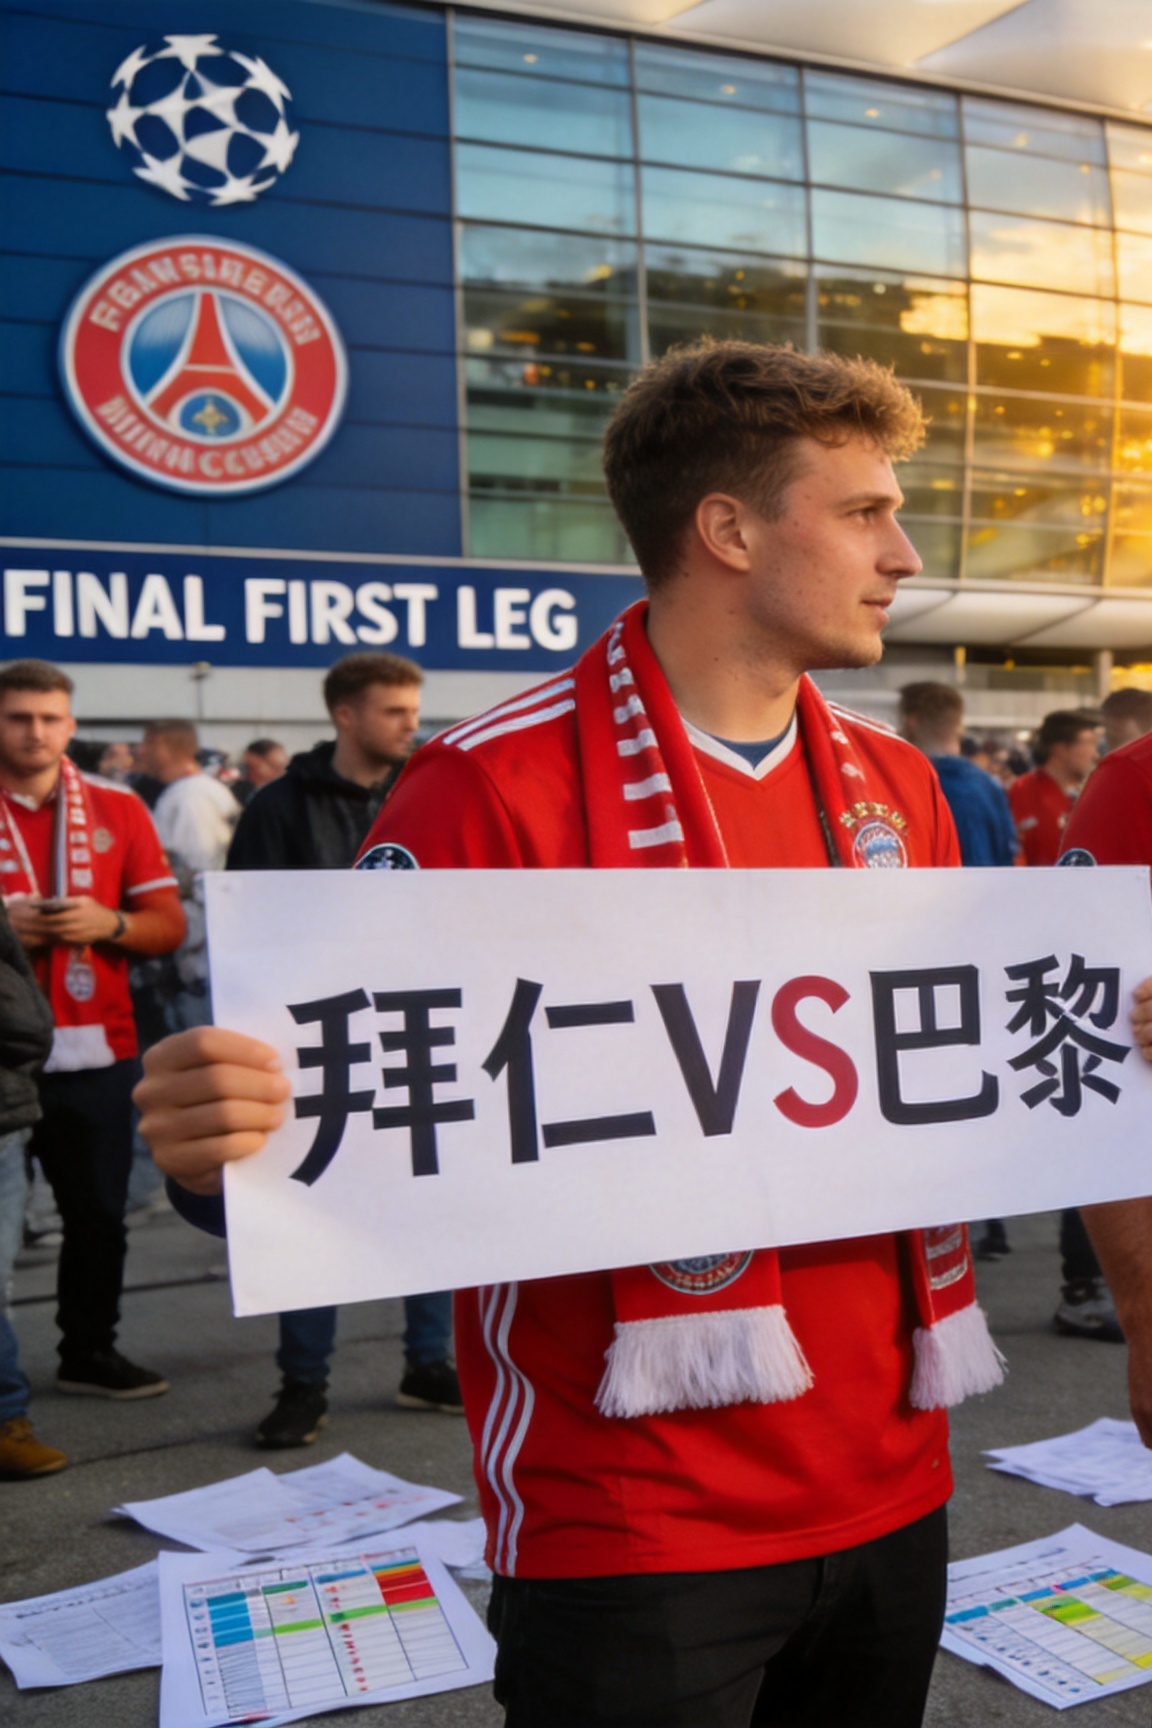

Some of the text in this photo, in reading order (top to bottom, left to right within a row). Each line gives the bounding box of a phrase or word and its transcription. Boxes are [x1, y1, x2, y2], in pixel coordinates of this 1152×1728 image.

[4, 568, 578, 651] FINAL FIRST LEG
[286, 953, 1133, 1188] 拜仁VS巴黎
